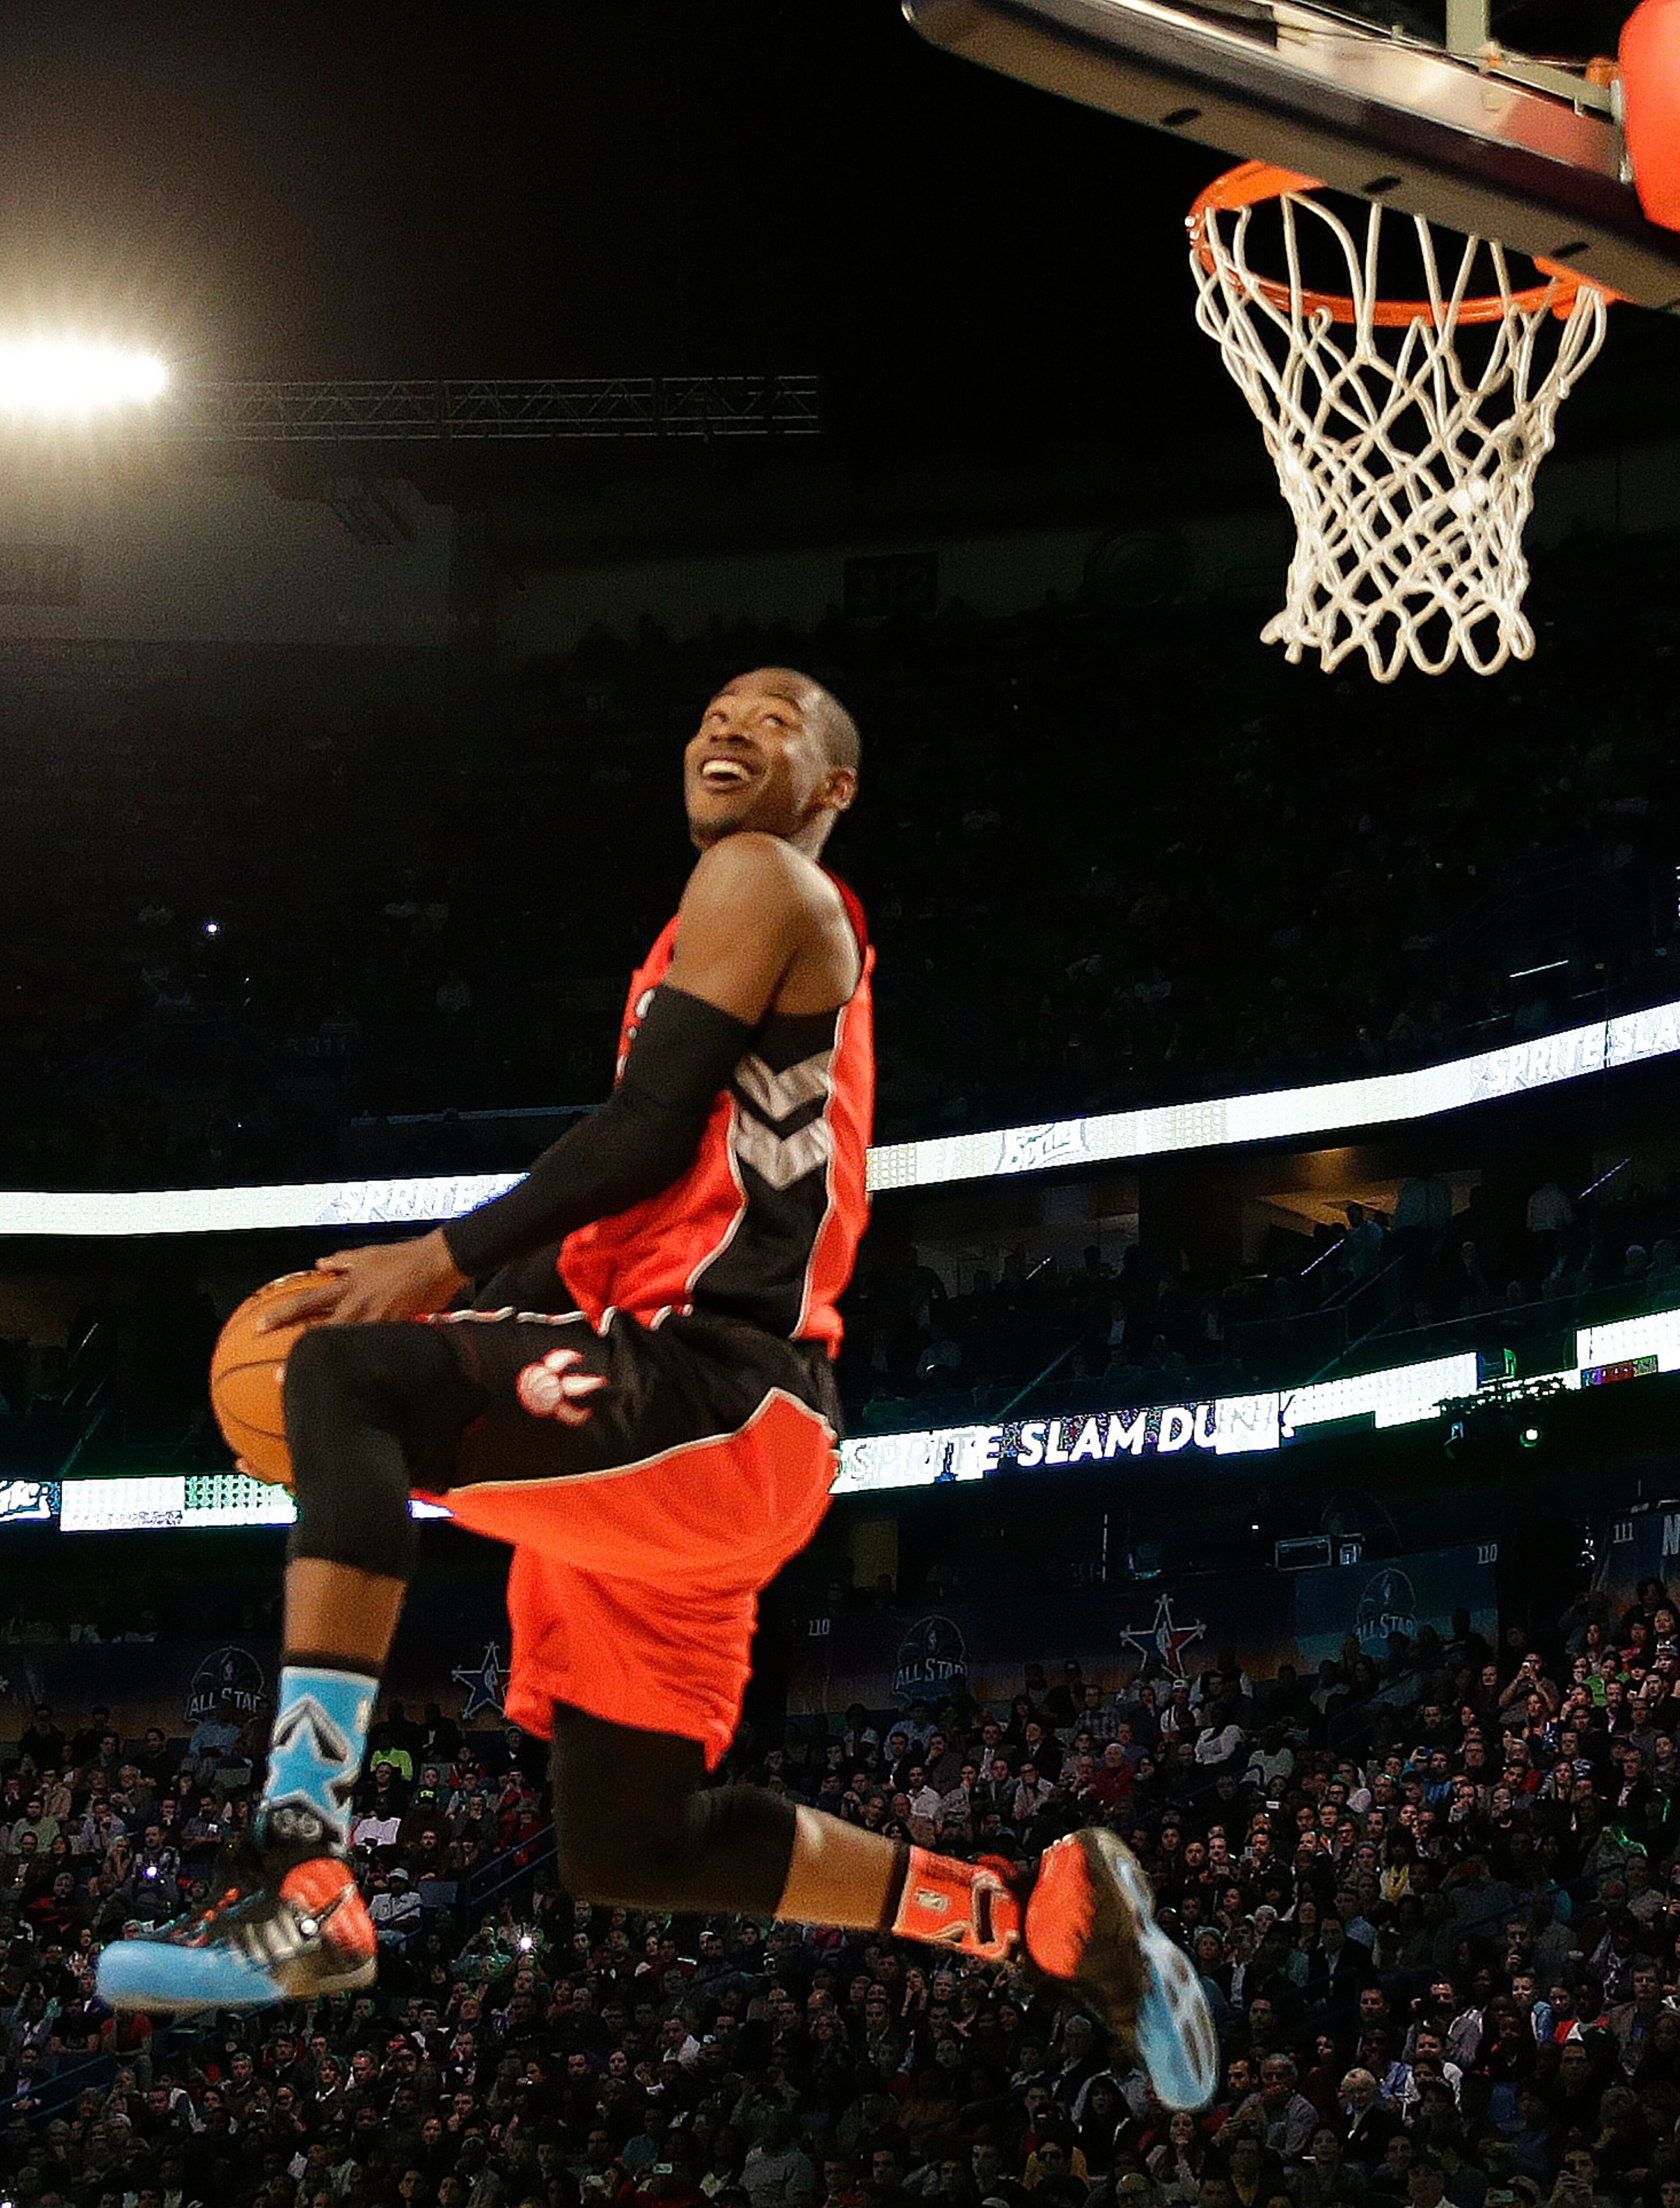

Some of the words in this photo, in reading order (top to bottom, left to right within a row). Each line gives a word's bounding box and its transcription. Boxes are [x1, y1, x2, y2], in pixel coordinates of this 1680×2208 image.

[1488, 1026, 1603, 1092] SPRITE
[850, 1425, 1002, 1481] SPRITE
[1018, 1411, 1147, 1466] SLAM
[1613, 1522, 1634, 1544] 111
[1477, 1543, 1498, 1564] 110
[807, 1618, 831, 1636] 110
[895, 1663, 922, 1690] ALL
[188, 1692, 217, 1718] ALL
